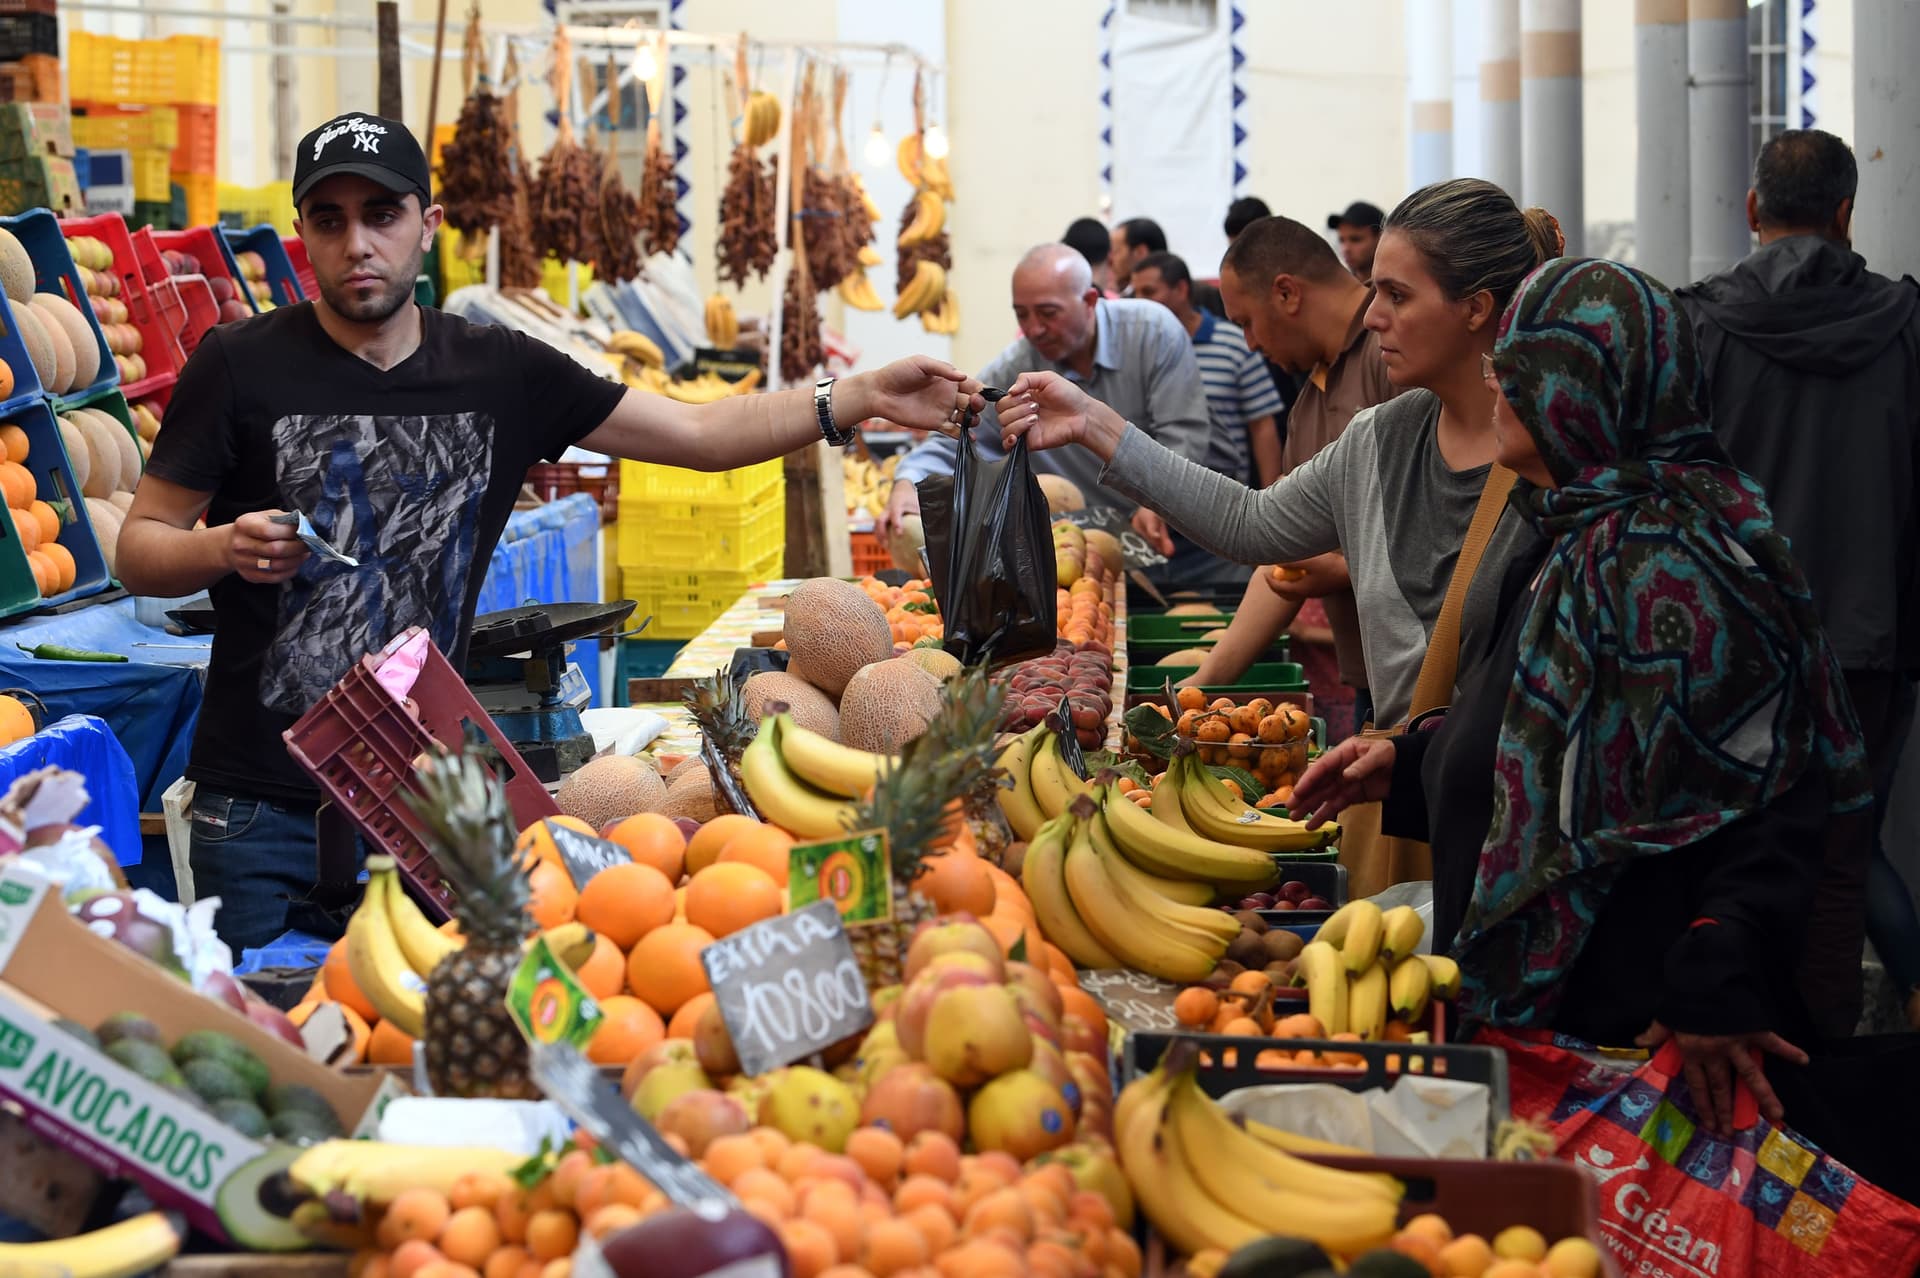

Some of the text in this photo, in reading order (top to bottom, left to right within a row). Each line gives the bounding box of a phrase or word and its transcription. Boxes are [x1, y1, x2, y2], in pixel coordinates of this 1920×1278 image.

[313, 118, 388, 161] Yankees
[352, 132, 380, 154] NY
[738, 959, 868, 1052] 10800
[24, 1049, 225, 1190] AVOCADOS
